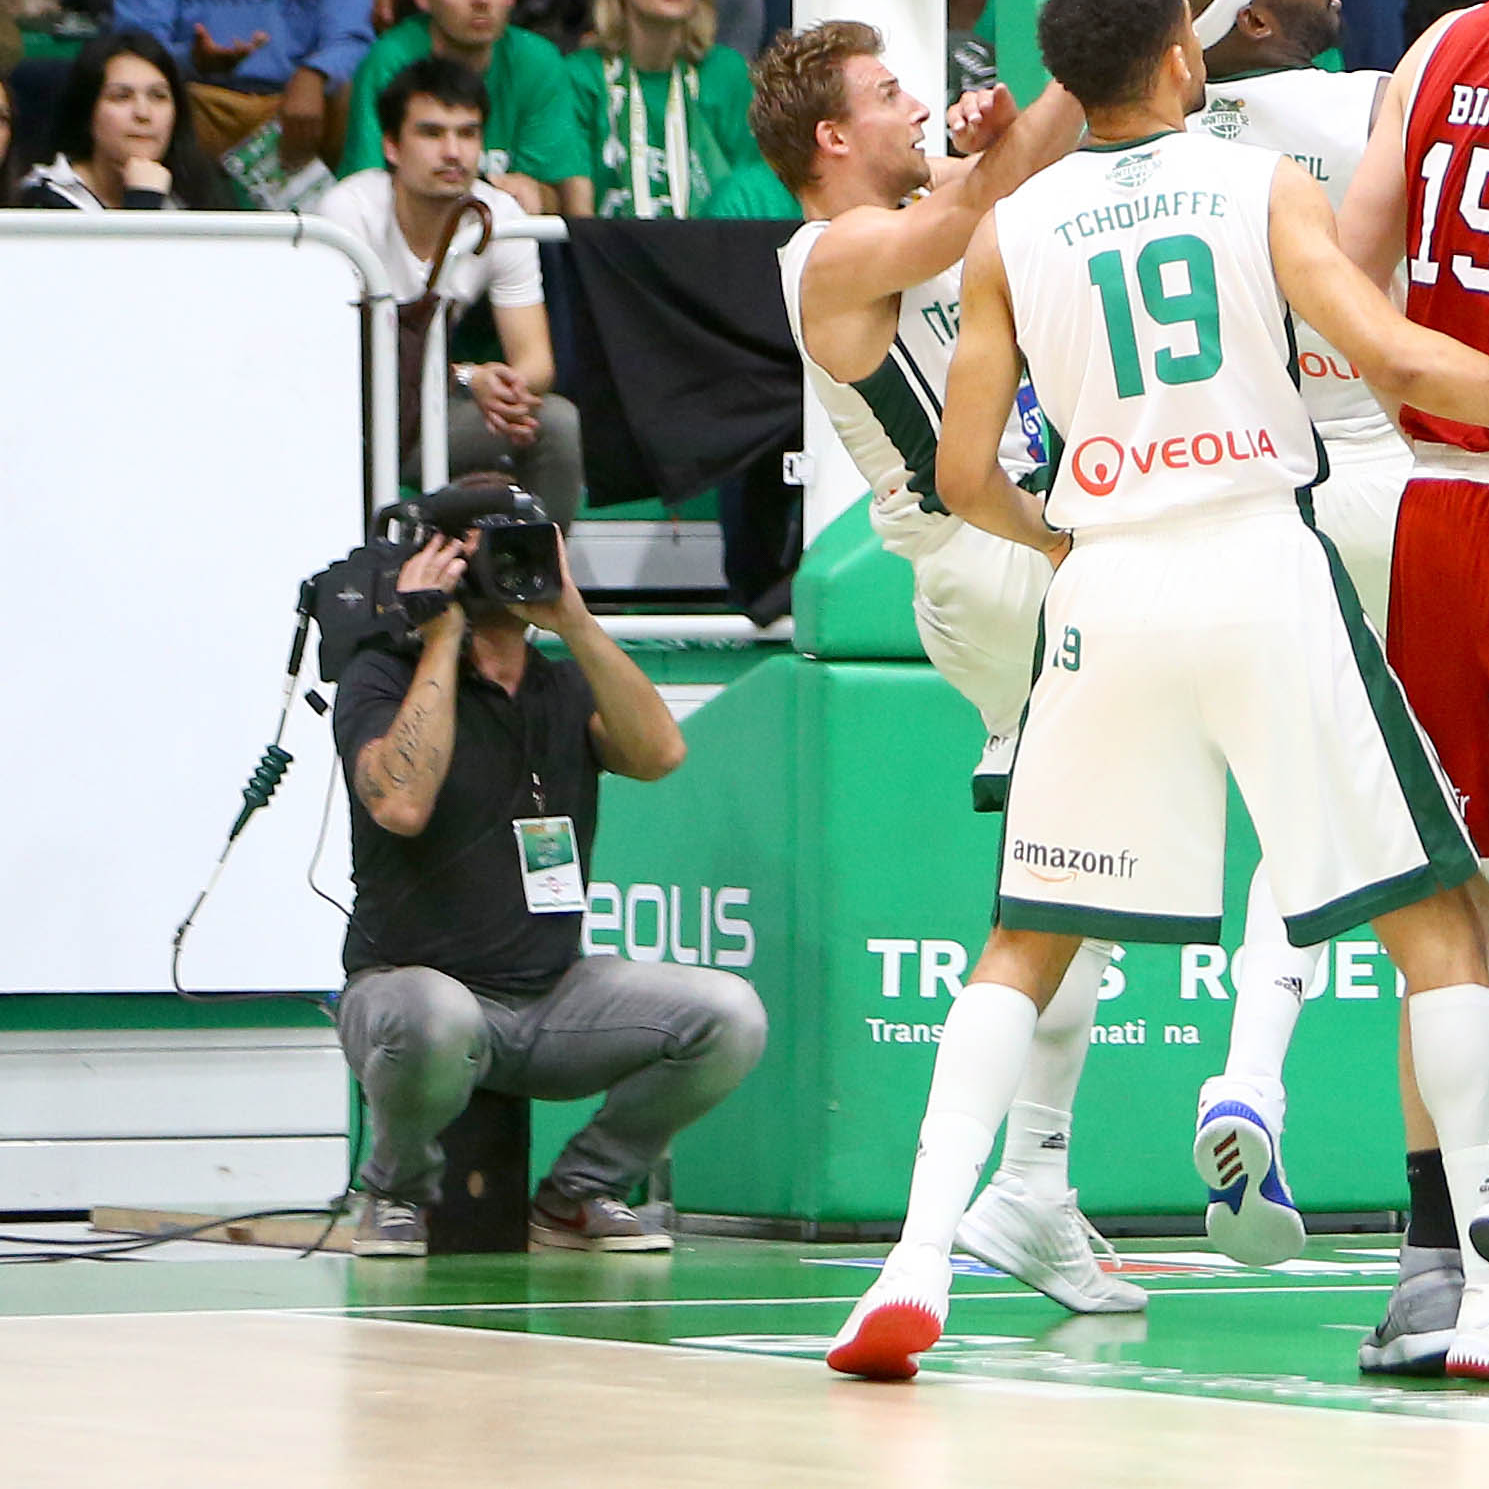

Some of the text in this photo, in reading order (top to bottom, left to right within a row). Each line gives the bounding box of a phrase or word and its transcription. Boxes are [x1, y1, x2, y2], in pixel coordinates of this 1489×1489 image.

[1053, 191, 1228, 247] TCHOUAFFE
[1087, 233, 1224, 400] 19
[1130, 426, 1279, 475] VEOLIA
[1013, 838, 1139, 879] amazon.fr
